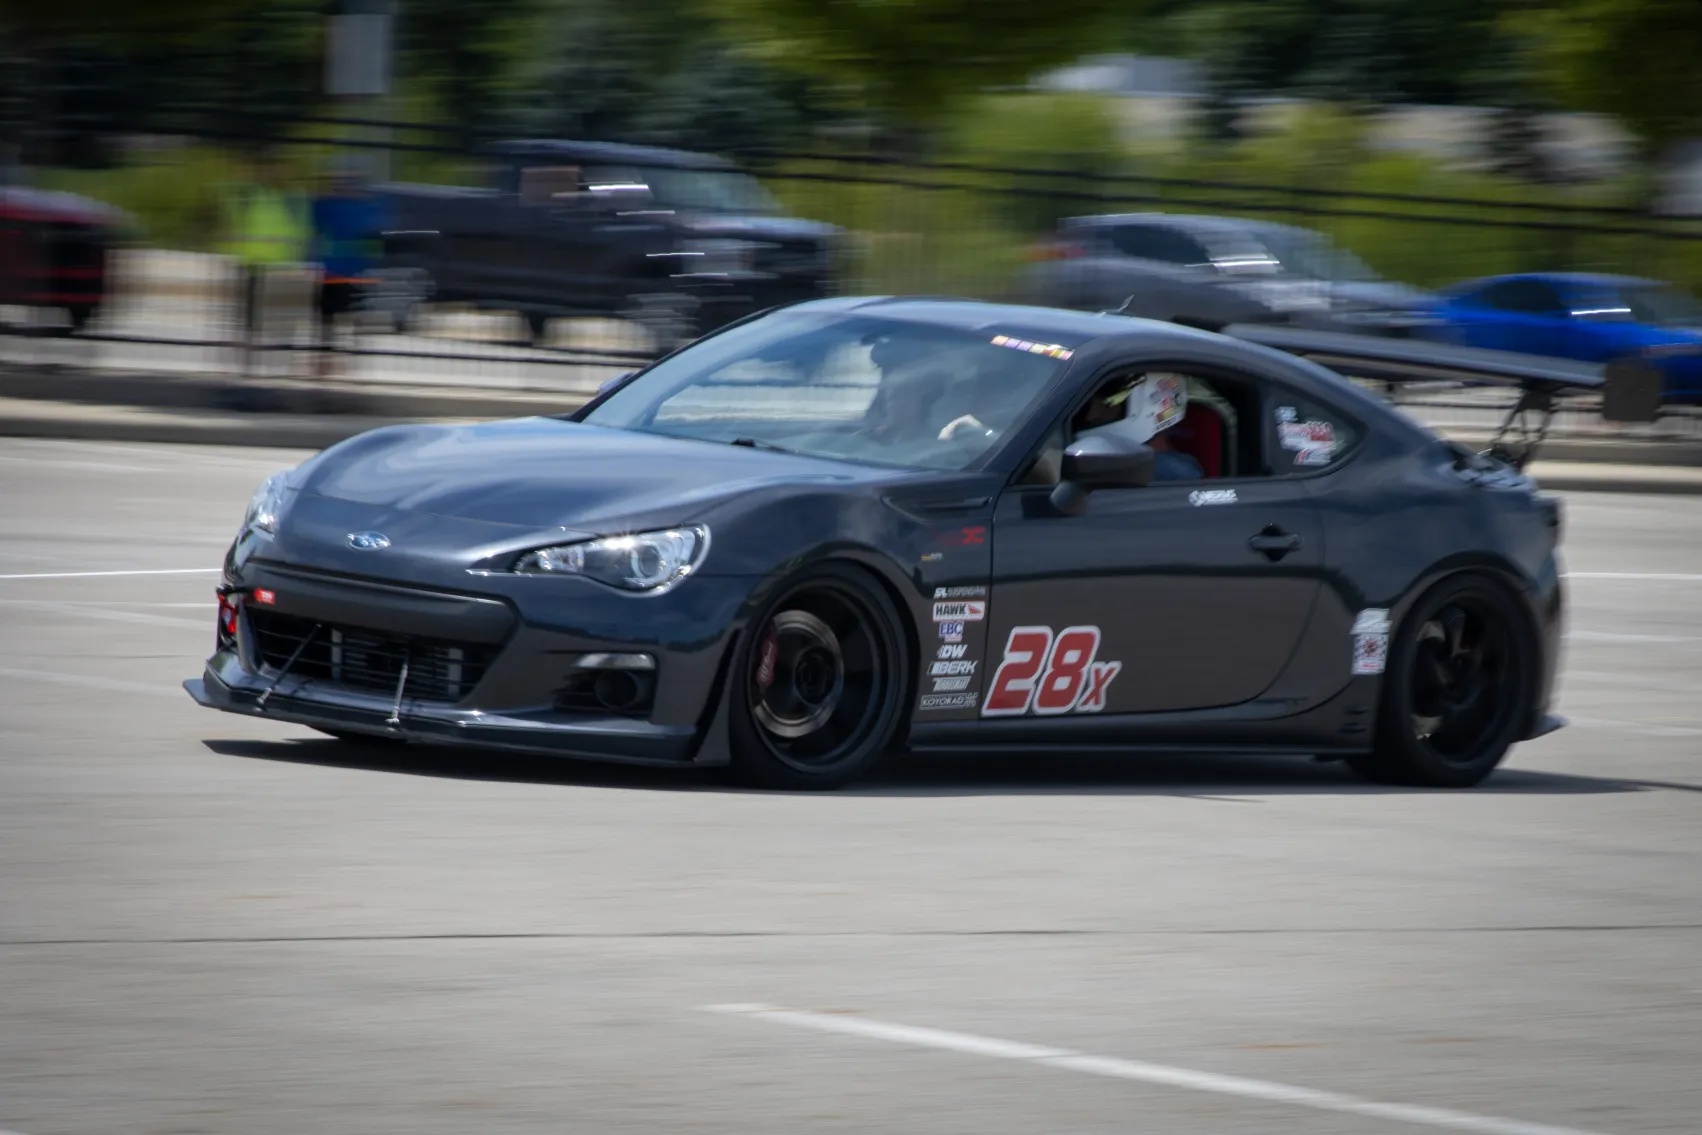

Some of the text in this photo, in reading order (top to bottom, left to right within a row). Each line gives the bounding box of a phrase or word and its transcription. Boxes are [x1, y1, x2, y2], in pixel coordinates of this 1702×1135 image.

[935, 603, 968, 616] HAWK
[940, 621, 963, 635] EBC
[938, 644, 968, 659] DW
[937, 660, 978, 675] BERK
[922, 695, 965, 707] KOYORAD
